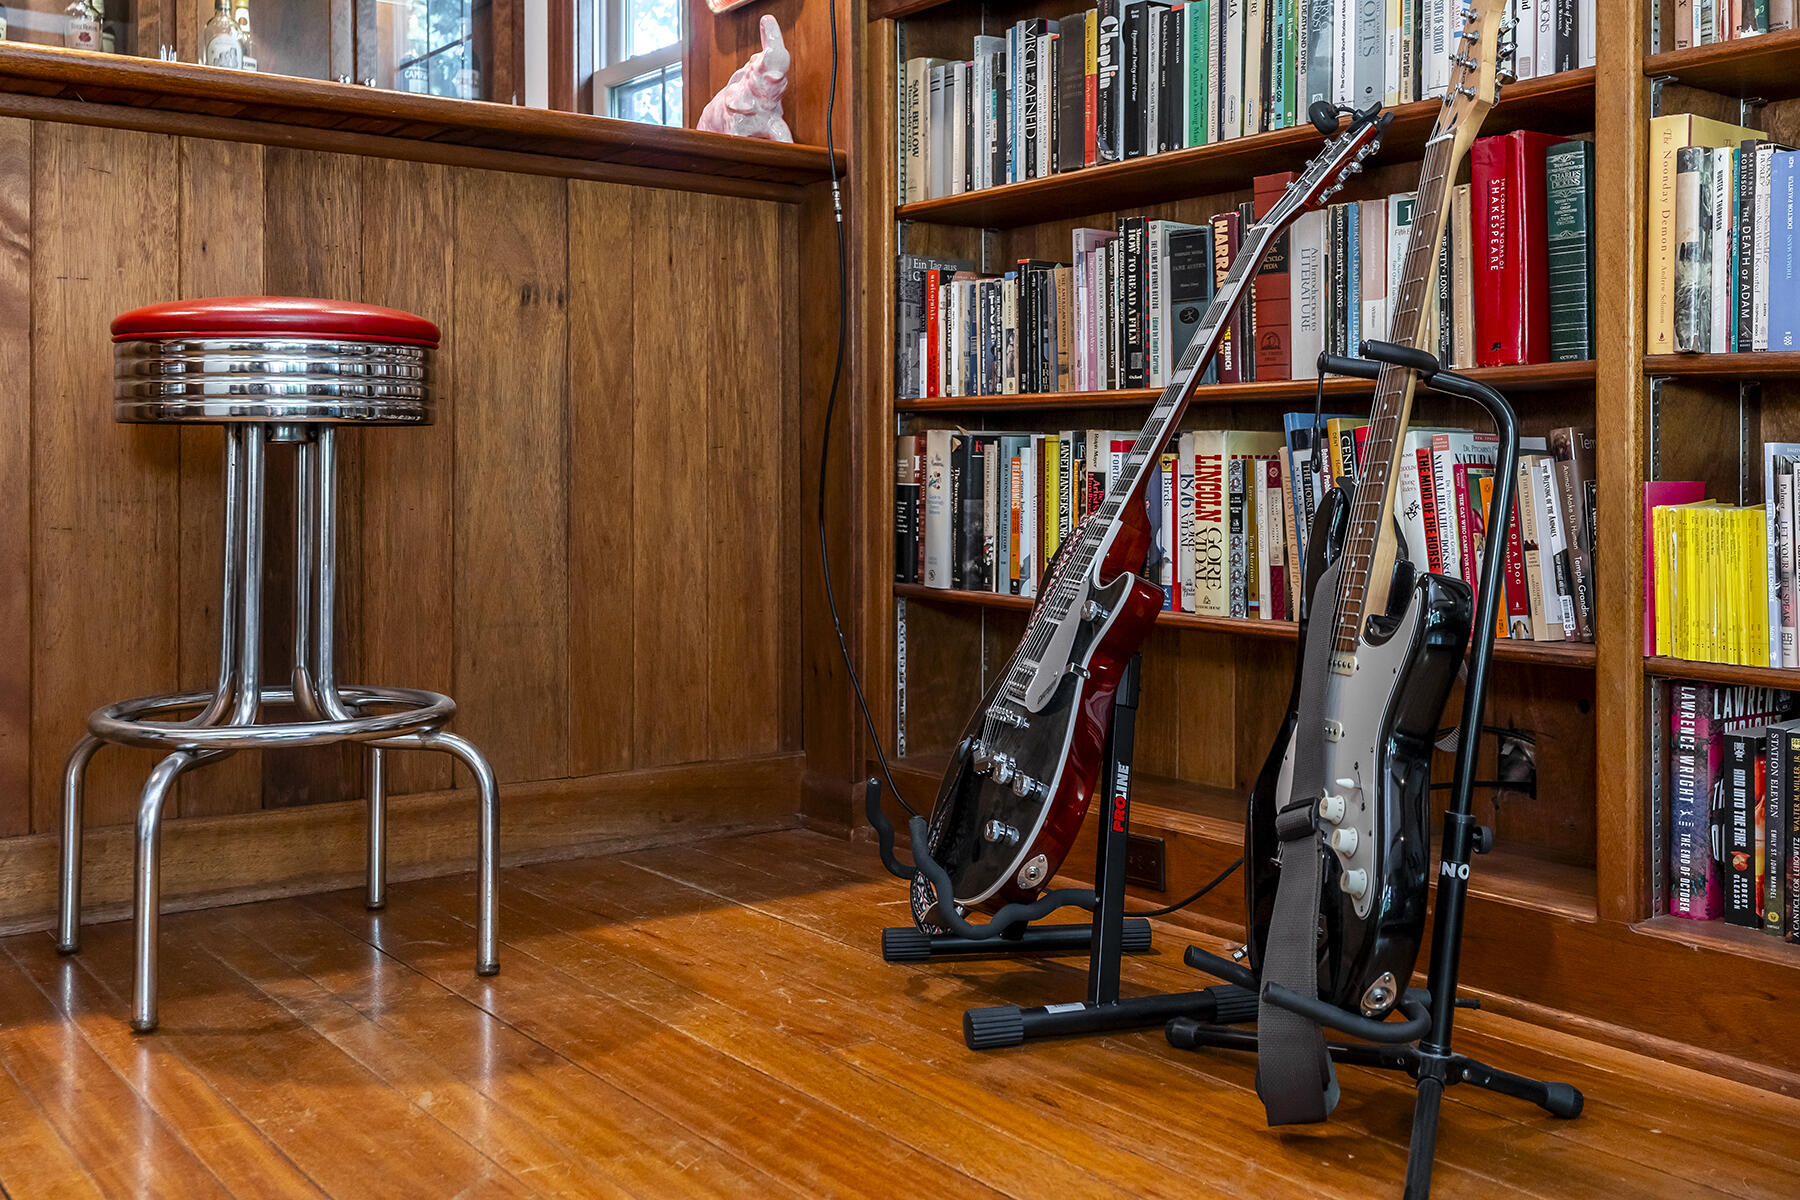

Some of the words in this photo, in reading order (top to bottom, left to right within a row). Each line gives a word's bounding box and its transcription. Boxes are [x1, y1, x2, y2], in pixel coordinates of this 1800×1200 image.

[1433, 0, 1445, 16] SONG
[1433, 16, 1445, 24] OF
[1025, 23, 1037, 67] VIRGIL
[1097, 16, 1119, 89] Chaplin
[1402, 39, 1410, 52] Joyce
[1433, 26, 1445, 55] SOLOMON
[1402, 53, 1410, 65] Carol
[1402, 65, 1410, 78] Oates
[912, 79, 920, 109] SAUL
[912, 112, 920, 158] BELLOW
[1662, 128, 1673, 145] The
[1550, 170, 1582, 182] CHARLES
[1659, 150, 1672, 204] Noonday
[1740, 153, 1748, 197] ROBINSON
[1758, 153, 1767, 187] HUXLEY
[1742, 206, 1750, 223] THE
[1755, 193, 1763, 214] Brave
[1336, 206, 1344, 242] BRADLEY
[1490, 179, 1500, 271] SHAKESPEARE
[1660, 209, 1671, 252] Demon
[1128, 229, 1137, 253] HOW
[1151, 241, 1159, 249] THE
[1310, 247, 1319, 262] An
[1741, 225, 1751, 266] DEATH
[1128, 256, 1137, 272] TO
[1151, 250, 1159, 264] FILMS
[1335, 247, 1344, 279] BEATTY
[1151, 271, 1159, 290] WERNER
[1741, 269, 1749, 280] OF
[1754, 257, 1762, 294] Revisited
[1128, 274, 1137, 306] READ
[1151, 291, 1160, 310] HERZOG
[1301, 249, 1311, 333] LITERATURE
[1310, 263, 1319, 321] Introduction
[1741, 283, 1751, 319] ADAM
[1128, 307, 1137, 316] A
[1128, 318, 1137, 345] FILM
[1310, 322, 1318, 332] to
[1225, 342, 1233, 370] FRENCH
[1060, 443, 1070, 470] JANET
[1320, 448, 1330, 473] Behavior
[1419, 453, 1431, 473] THE
[1011, 460, 1021, 510] FREAKONOMICS
[1323, 474, 1331, 494] Probl
[1434, 454, 1445, 493] NATURAL
[1562, 464, 1572, 493] Animals
[1060, 471, 1070, 515] FLANNER'S
[1092, 480, 1101, 513] Artist's
[1163, 478, 1172, 507] Birds
[1180, 473, 1195, 508] 1876
[1194, 454, 1222, 523] LINCOLN
[1420, 475, 1433, 500] MIND
[1779, 483, 1788, 510] Palmer
[1423, 502, 1433, 514] OF
[1436, 494, 1448, 529] HEALTH
[1543, 474, 1552, 499] BLESSING
[1548, 515, 1558, 538] ANIMALS
[1565, 493, 1575, 513] Make
[1059, 516, 1070, 543] WORL
[1180, 512, 1188, 548] VIDAL
[1286, 513, 1295, 537] With
[1424, 516, 1436, 534] THE
[1570, 525, 1579, 550] Human
[1780, 521, 1789, 539] LET
[1427, 536, 1441, 569] HORSE
[1442, 539, 1451, 561] DOGS
[1511, 533, 1518, 547] OF
[1194, 526, 1208, 589] VIDAL
[1206, 527, 1223, 591] GORE
[1288, 540, 1300, 588] Charley
[1781, 541, 1789, 569] YOUR
[1513, 562, 1522, 585] DOG
[1572, 555, 1584, 584] Temple
[1578, 584, 1590, 618] Grandin
[1781, 571, 1790, 591] LIFE
[1782, 593, 1791, 622] SPEAK
[1713, 687, 1775, 720] LAWREN
[1679, 686, 1696, 750] LAWRENCE
[1770, 733, 1780, 777] STATION
[1679, 755, 1695, 804] WRIGHT
[1733, 768, 1746, 787] AND
[1113, 761, 1130, 833] PROLINE
[1733, 788, 1747, 810] INTO
[1769, 779, 1779, 818] ELEVEN
[1733, 810, 1747, 828] THE
[1680, 832, 1691, 847] THE
[1733, 828, 1747, 847] FIRE
[1770, 829, 1778, 847] EMILY
[1680, 848, 1691, 865] END
[1769, 859, 1777, 875] JOHN
[1441, 861, 1470, 880] NO
[1680, 866, 1690, 876] OF
[1679, 877, 1691, 912] OCTOBER
[1733, 873, 1741, 910] GLEASON
[1769, 875, 1777, 899] MANDEL
